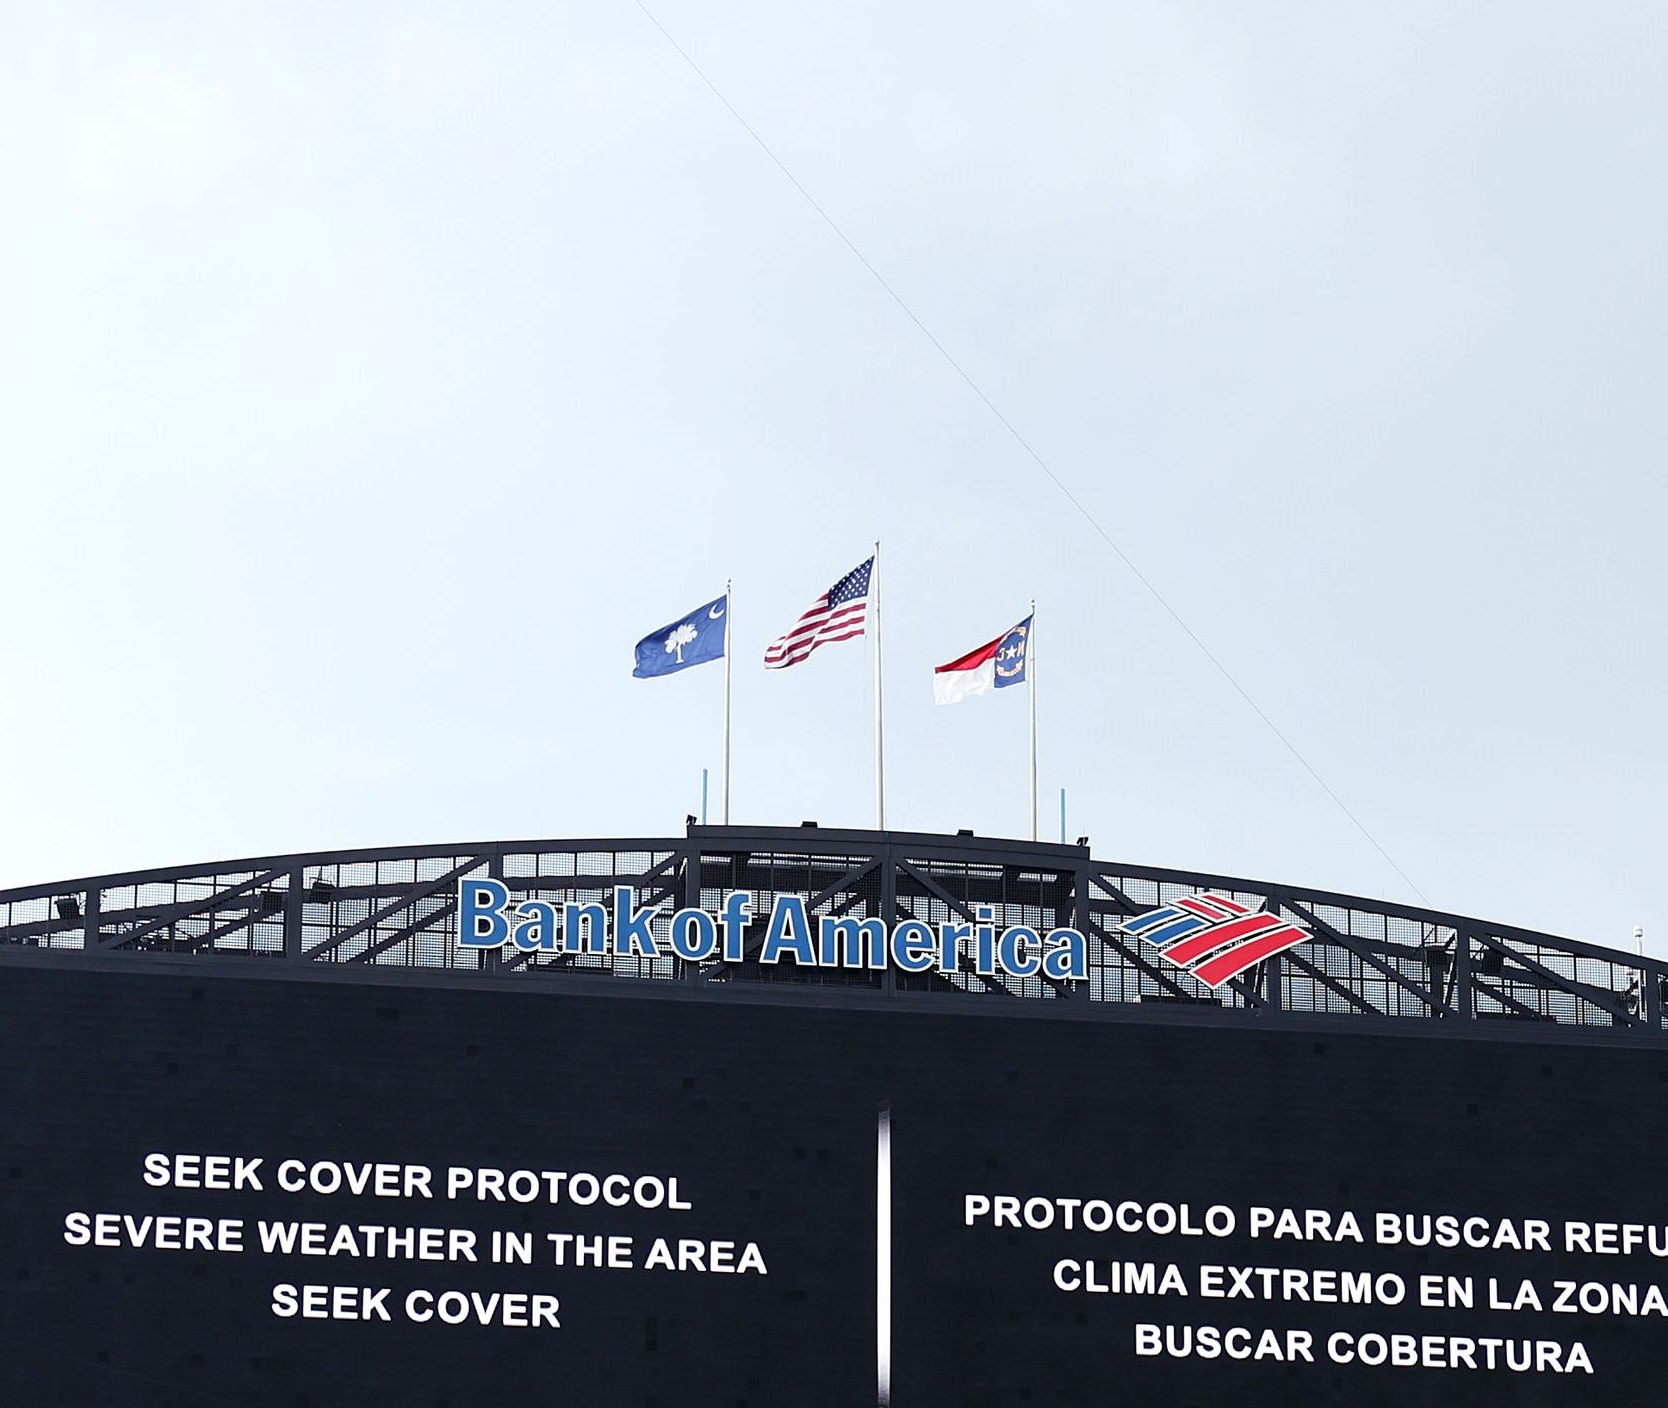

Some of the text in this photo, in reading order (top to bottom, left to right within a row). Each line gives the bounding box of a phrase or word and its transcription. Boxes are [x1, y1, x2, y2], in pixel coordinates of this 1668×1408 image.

[457, 877, 1090, 981] Bank of America
[143, 1153, 692, 1210] SEEK COVER PROTOCOL
[63, 1212, 768, 1275] SEVERE WEATHER IN THE AREA
[965, 1194, 1236, 1237] PROTOCOLO
[1250, 1206, 1364, 1243] PARA
[1375, 1212, 1552, 1251] BUSCAR
[271, 1283, 561, 1328] SEEK COVER
[1053, 1259, 1188, 1296] CLIMA
[1200, 1265, 1406, 1305] EXTREMO
[1419, 1275, 1474, 1308] EN
[1489, 1278, 1543, 1311] LA
[1135, 1323, 1594, 1374] BUSCAR COBERTURA
